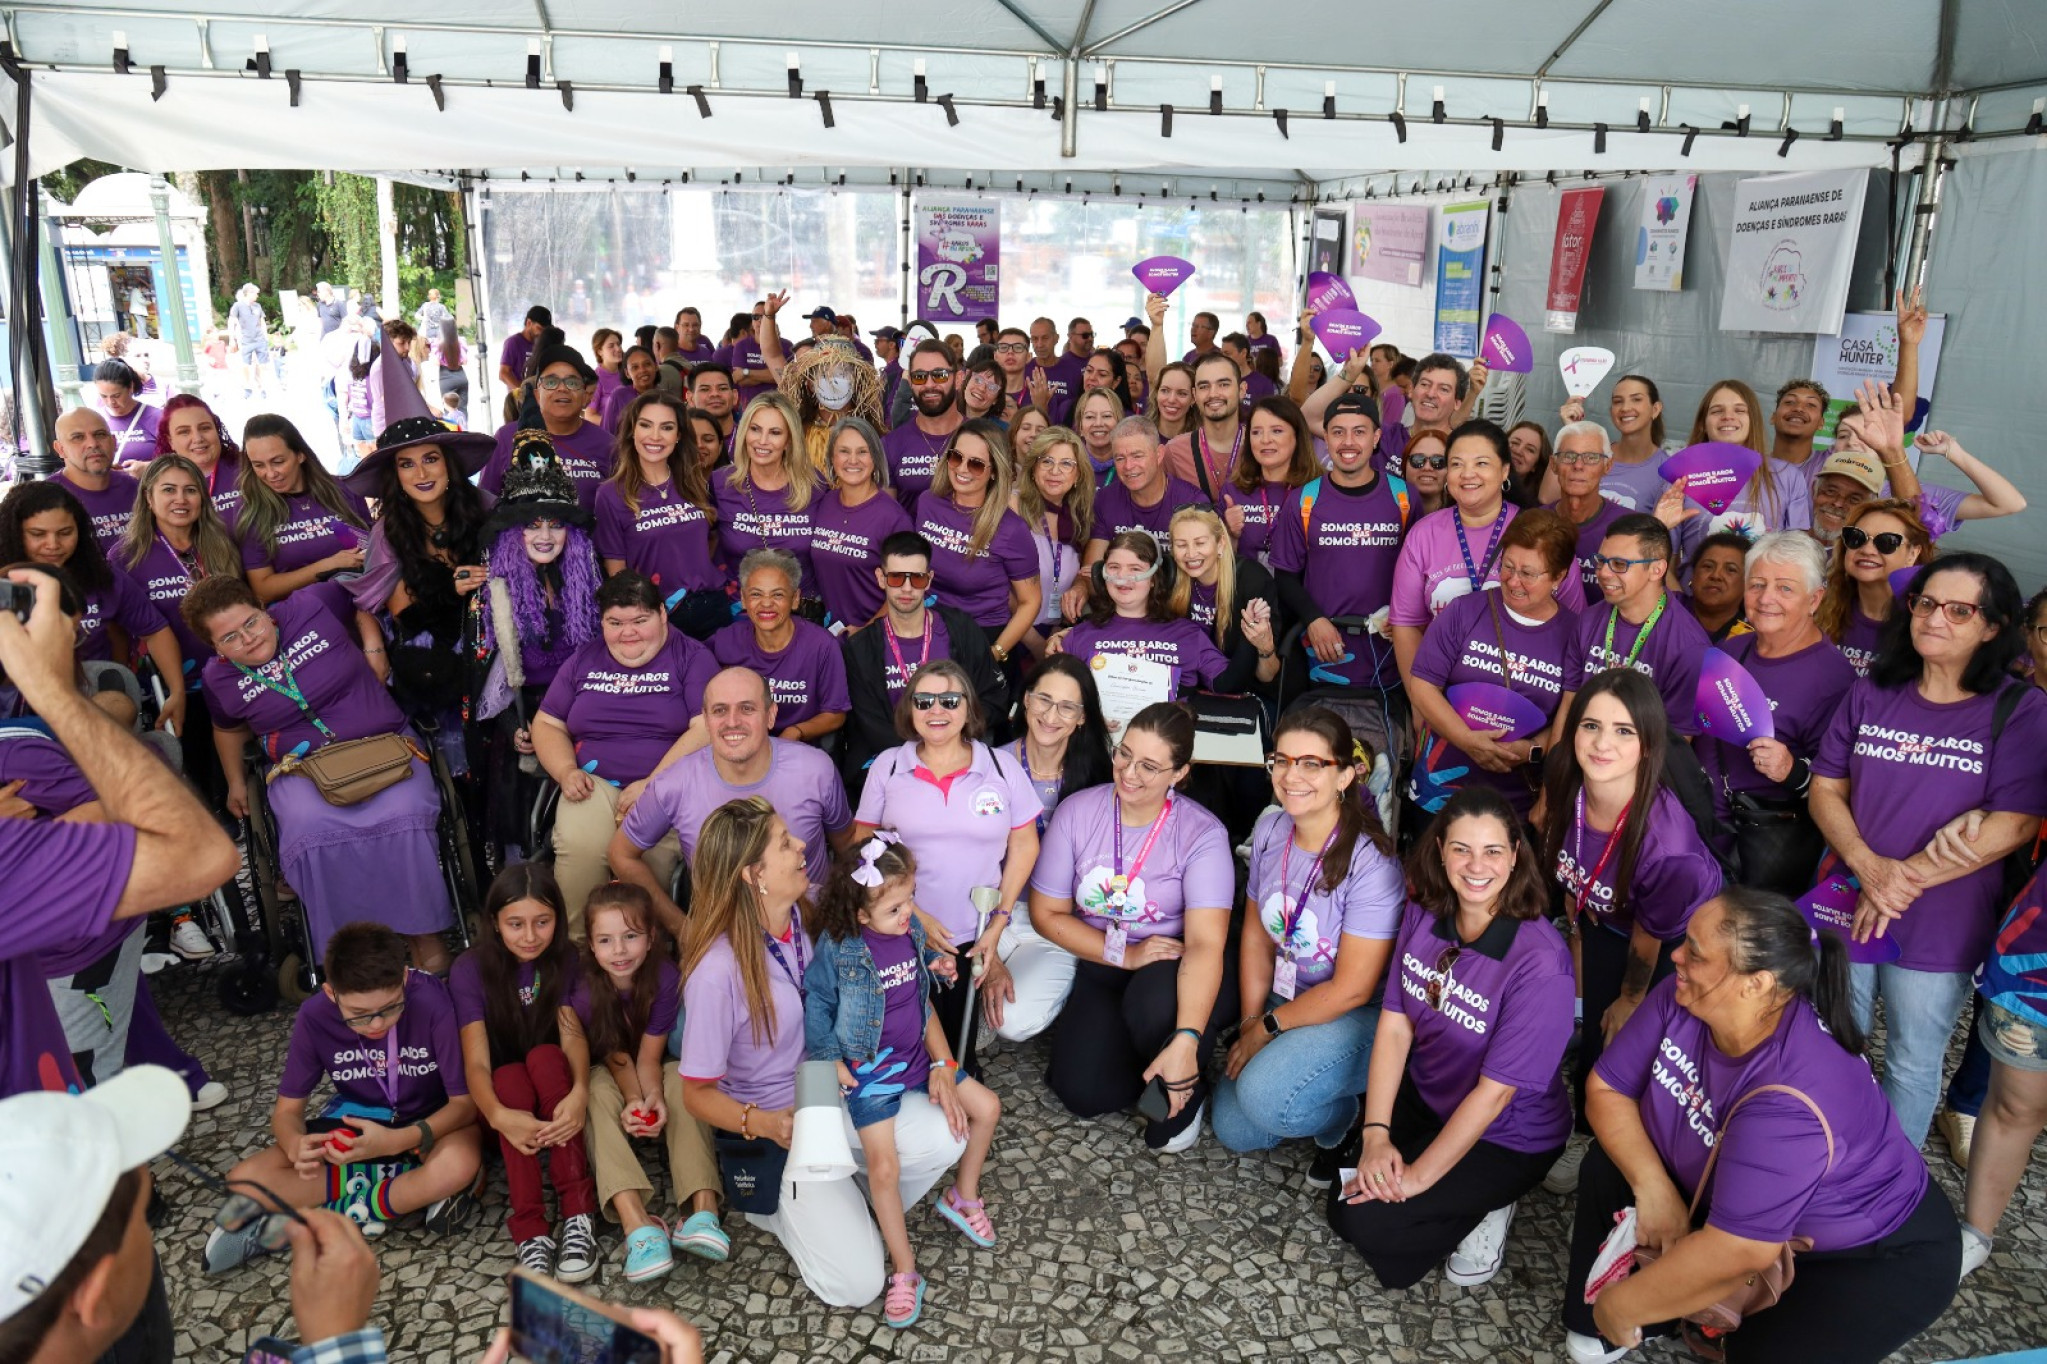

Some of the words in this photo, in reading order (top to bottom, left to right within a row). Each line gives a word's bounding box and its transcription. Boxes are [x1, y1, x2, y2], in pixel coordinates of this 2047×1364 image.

[1748, 195, 1780, 213] ALIANÇA
[1780, 191, 1830, 209] PARANAENSE
[1831, 189, 1843, 201] DE
[1736, 220, 1770, 234] DOENÇAS
[1771, 219, 1776, 229] E
[1776, 213, 1822, 228] SÍNDROMES
[1841, 338, 1874, 352] CASA
[1839, 350, 1884, 365] HUNTER
[636, 515, 678, 532] SOMOS
[735, 512, 772, 524] SOMOS
[774, 514, 810, 524] RAROS
[732, 522, 770, 536] SOMOS
[772, 526, 813, 537] MUITOS
[923, 520, 955, 537] SOMOS
[1320, 523, 1362, 532] SOMOS
[1362, 522, 1400, 532] RAROS
[814, 526, 838, 540] SOMOS
[840, 532, 869, 546] RAROS
[1318, 536, 1359, 546] SOMOS
[1361, 536, 1398, 546] MUITOS
[832, 545, 868, 560] MUITOS
[1094, 640, 1136, 650] SOMOS
[1138, 641, 1178, 652] RAROS
[1518, 653, 1562, 678] RAROS
[587, 672, 628, 682] SOMOS
[630, 672, 670, 682] RAROS
[768, 678, 806, 690] RAROS
[1510, 670, 1562, 694] MUITOS
[622, 684, 670, 694] MUITOS
[772, 693, 808, 704] UITOS
[1715, 680, 1732, 707] SOMOS
[1730, 705, 1746, 733] MUITOS
[1723, 678, 1740, 706] SOMOS
[1736, 702, 1754, 728] RAROS
[1858, 724, 1920, 744] SOMOS
[1922, 736, 1984, 755] RAROS
[1898, 742, 1929, 754] MAS
[1908, 750, 1983, 775] MUITOS
[1402, 952, 1446, 985] SOMOS
[1448, 976, 1490, 1012] RAROS
[1660, 1037, 1699, 1084] SOMO
[332, 1067, 386, 1082] SOMOS
[1652, 1057, 1690, 1106] OMOS
